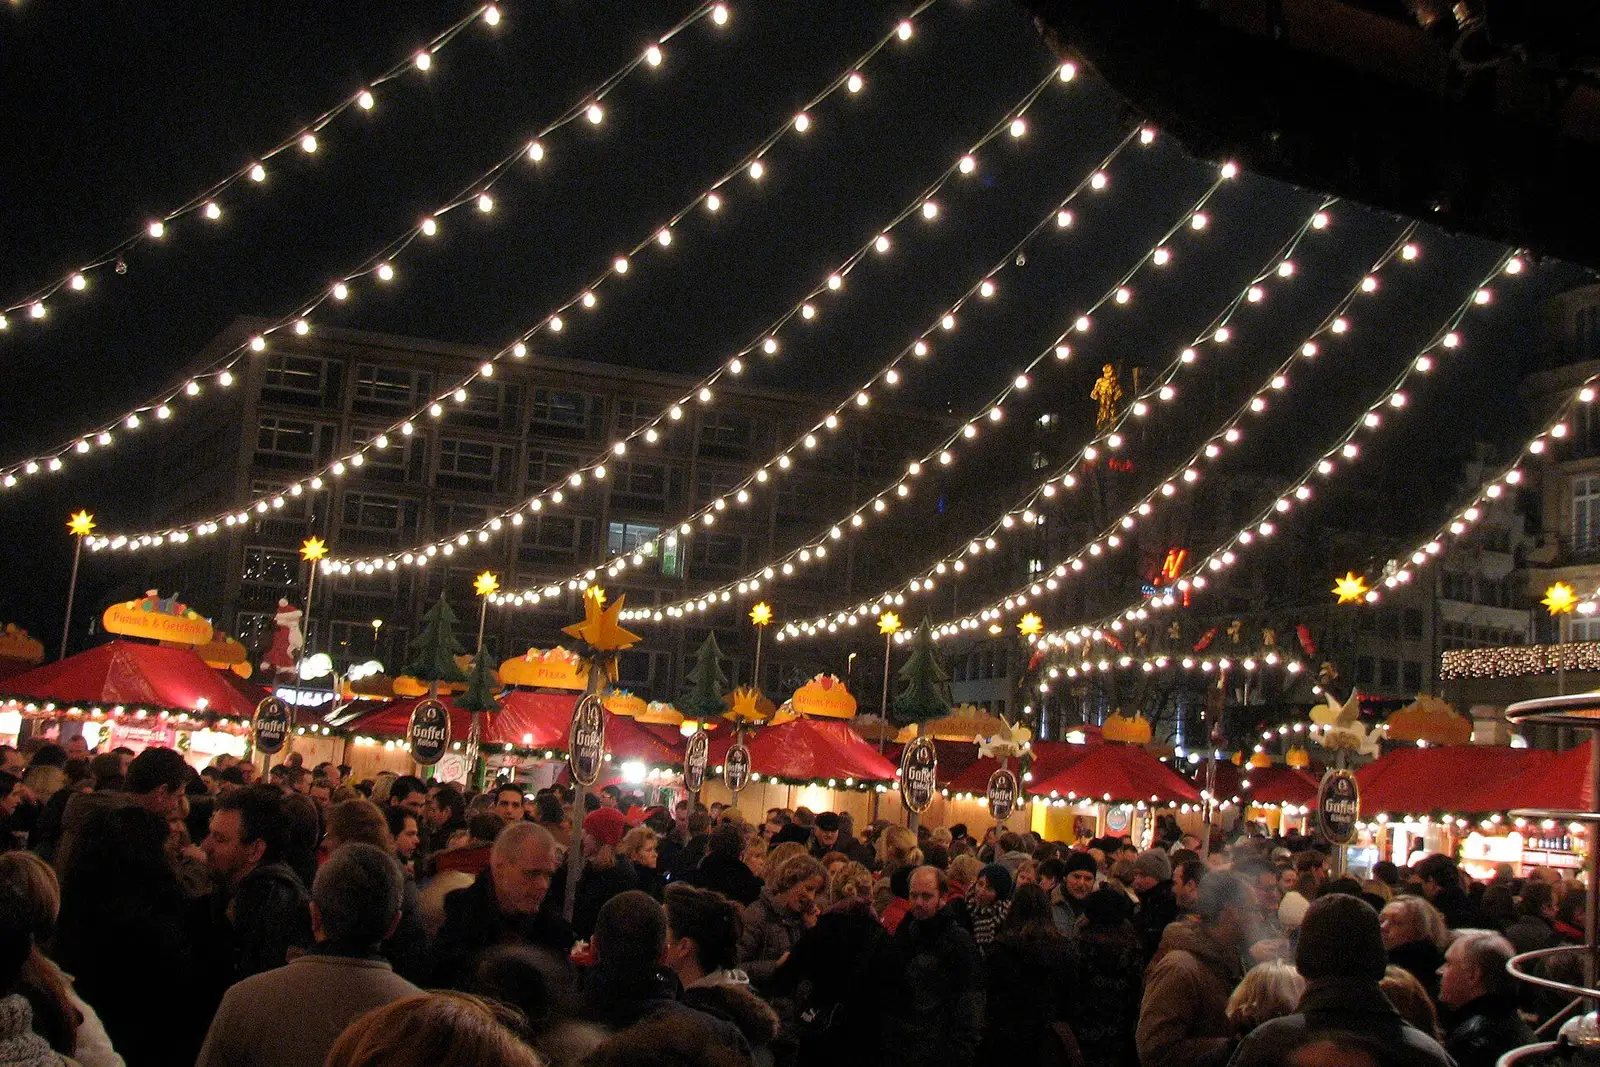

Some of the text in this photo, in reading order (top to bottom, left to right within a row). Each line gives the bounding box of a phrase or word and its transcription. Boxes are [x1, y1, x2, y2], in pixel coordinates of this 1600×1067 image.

[537, 667, 567, 680] Pizza
[257, 719, 286, 732] Gaffel
[413, 724, 445, 740] Gaffel
[989, 789, 1012, 801] Gaffel
[1326, 799, 1355, 814] Gaffel
